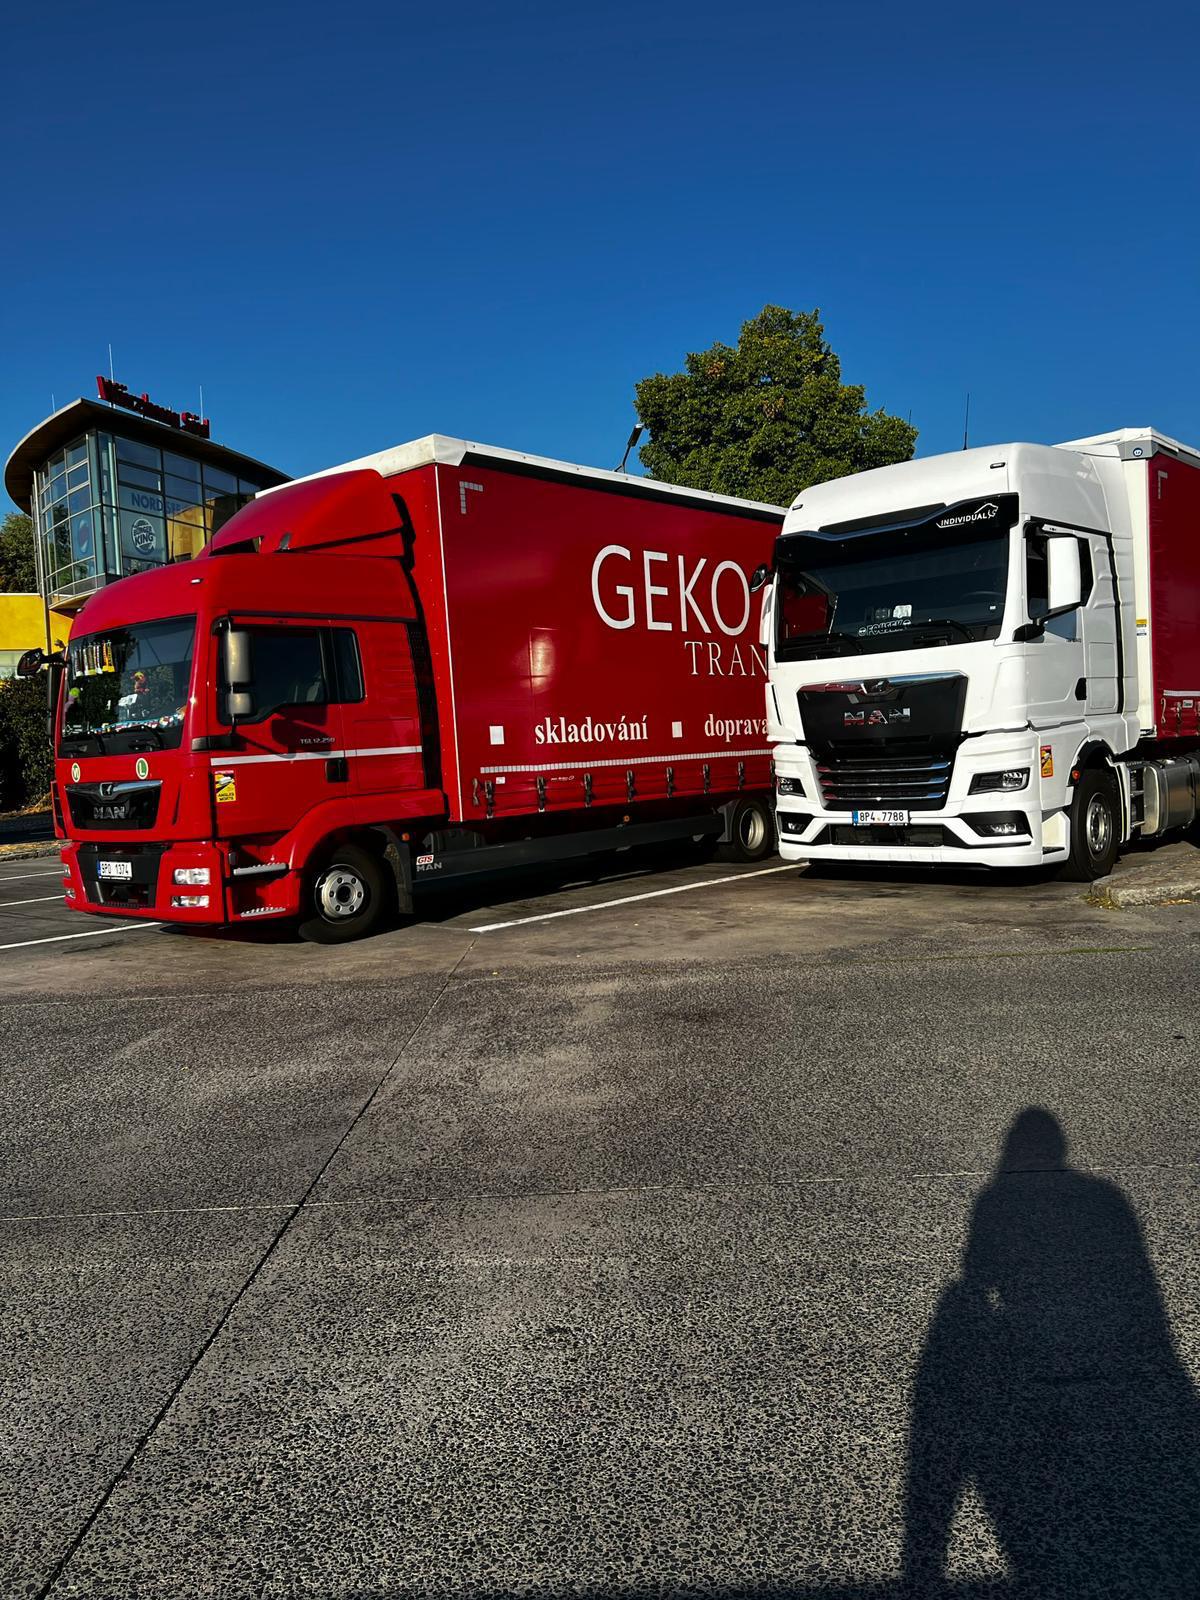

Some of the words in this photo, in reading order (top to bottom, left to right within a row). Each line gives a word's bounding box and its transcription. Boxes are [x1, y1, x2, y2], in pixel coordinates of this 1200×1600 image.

[940, 512, 987, 526] INDIVIDUAL
[135, 532, 154, 545] KING
[591, 544, 750, 636] GEKO
[844, 707, 911, 726] MAN
[534, 714, 648, 744] skladování
[93, 806, 126, 819] MAN
[860, 812, 875, 821] 8P4
[882, 812, 904, 821] 7788
[416, 862, 442, 872] MAN
